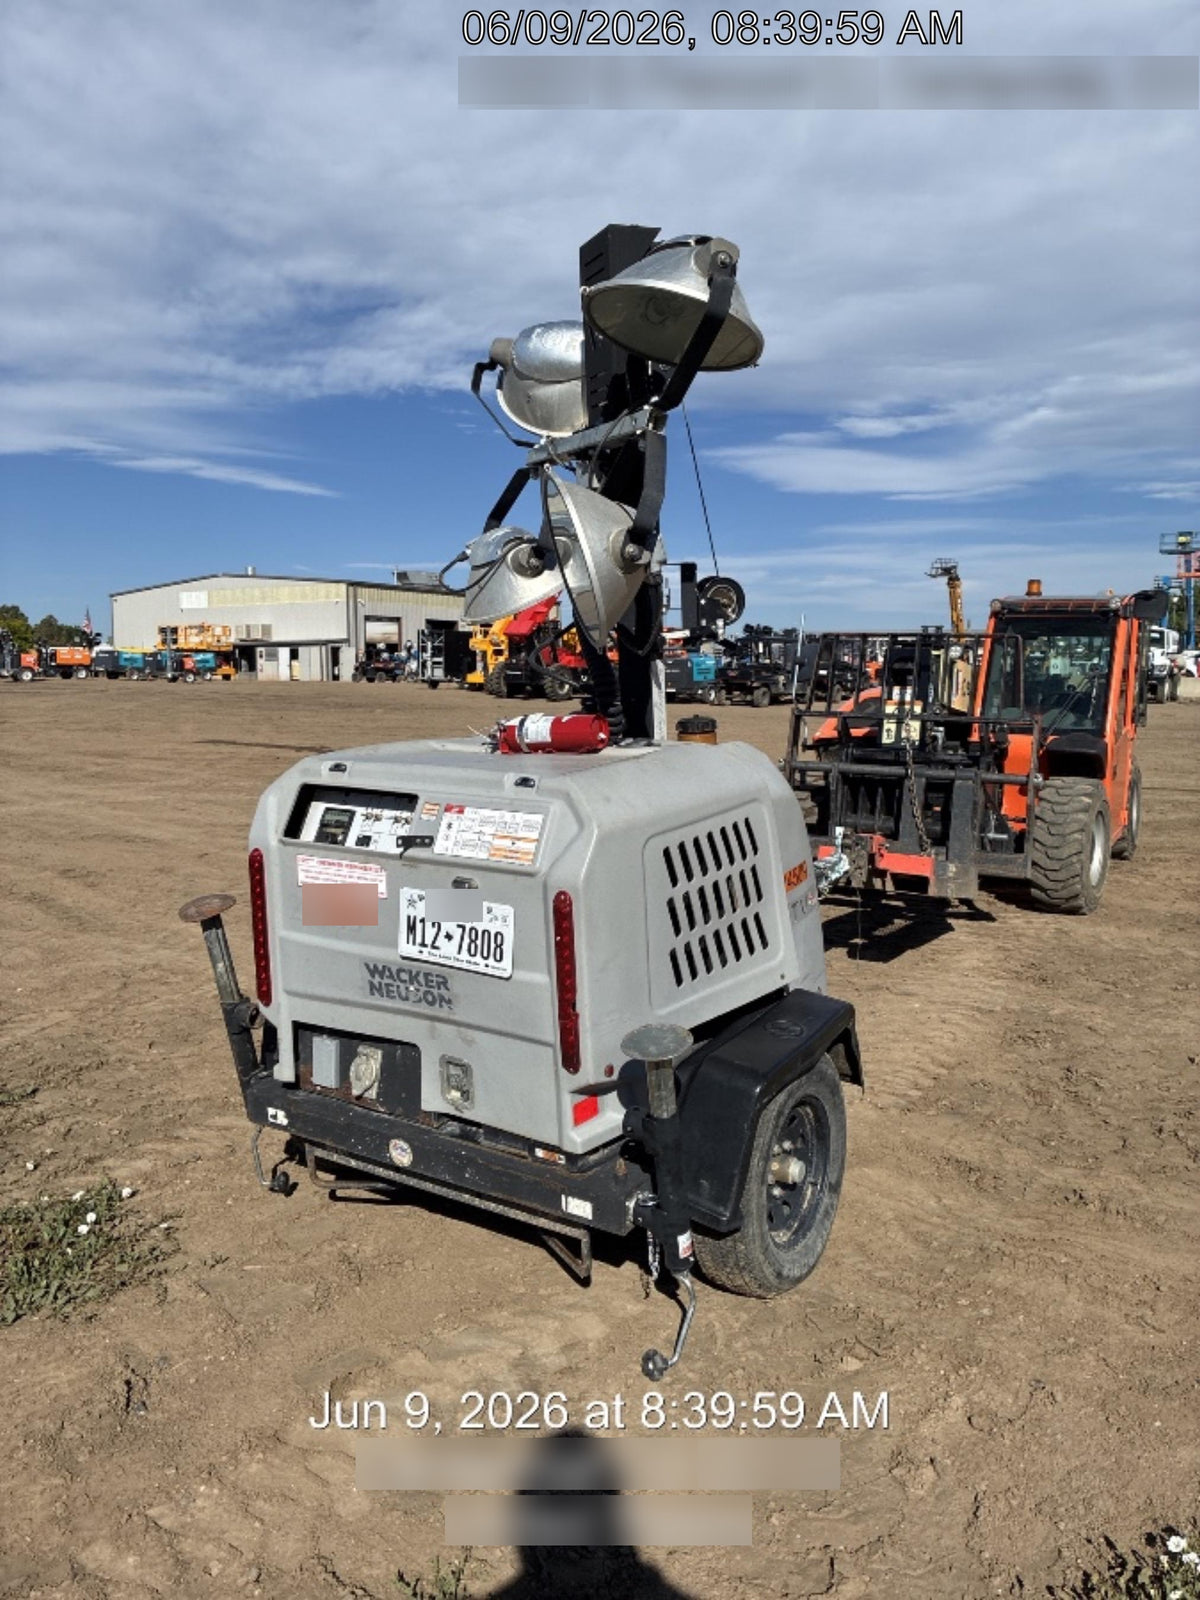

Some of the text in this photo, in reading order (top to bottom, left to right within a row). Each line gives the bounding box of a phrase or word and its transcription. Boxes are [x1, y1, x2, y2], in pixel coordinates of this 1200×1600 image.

[406, 914, 442, 950] M12
[456, 923, 504, 963] 7808
[363, 962, 450, 991] WACKER
